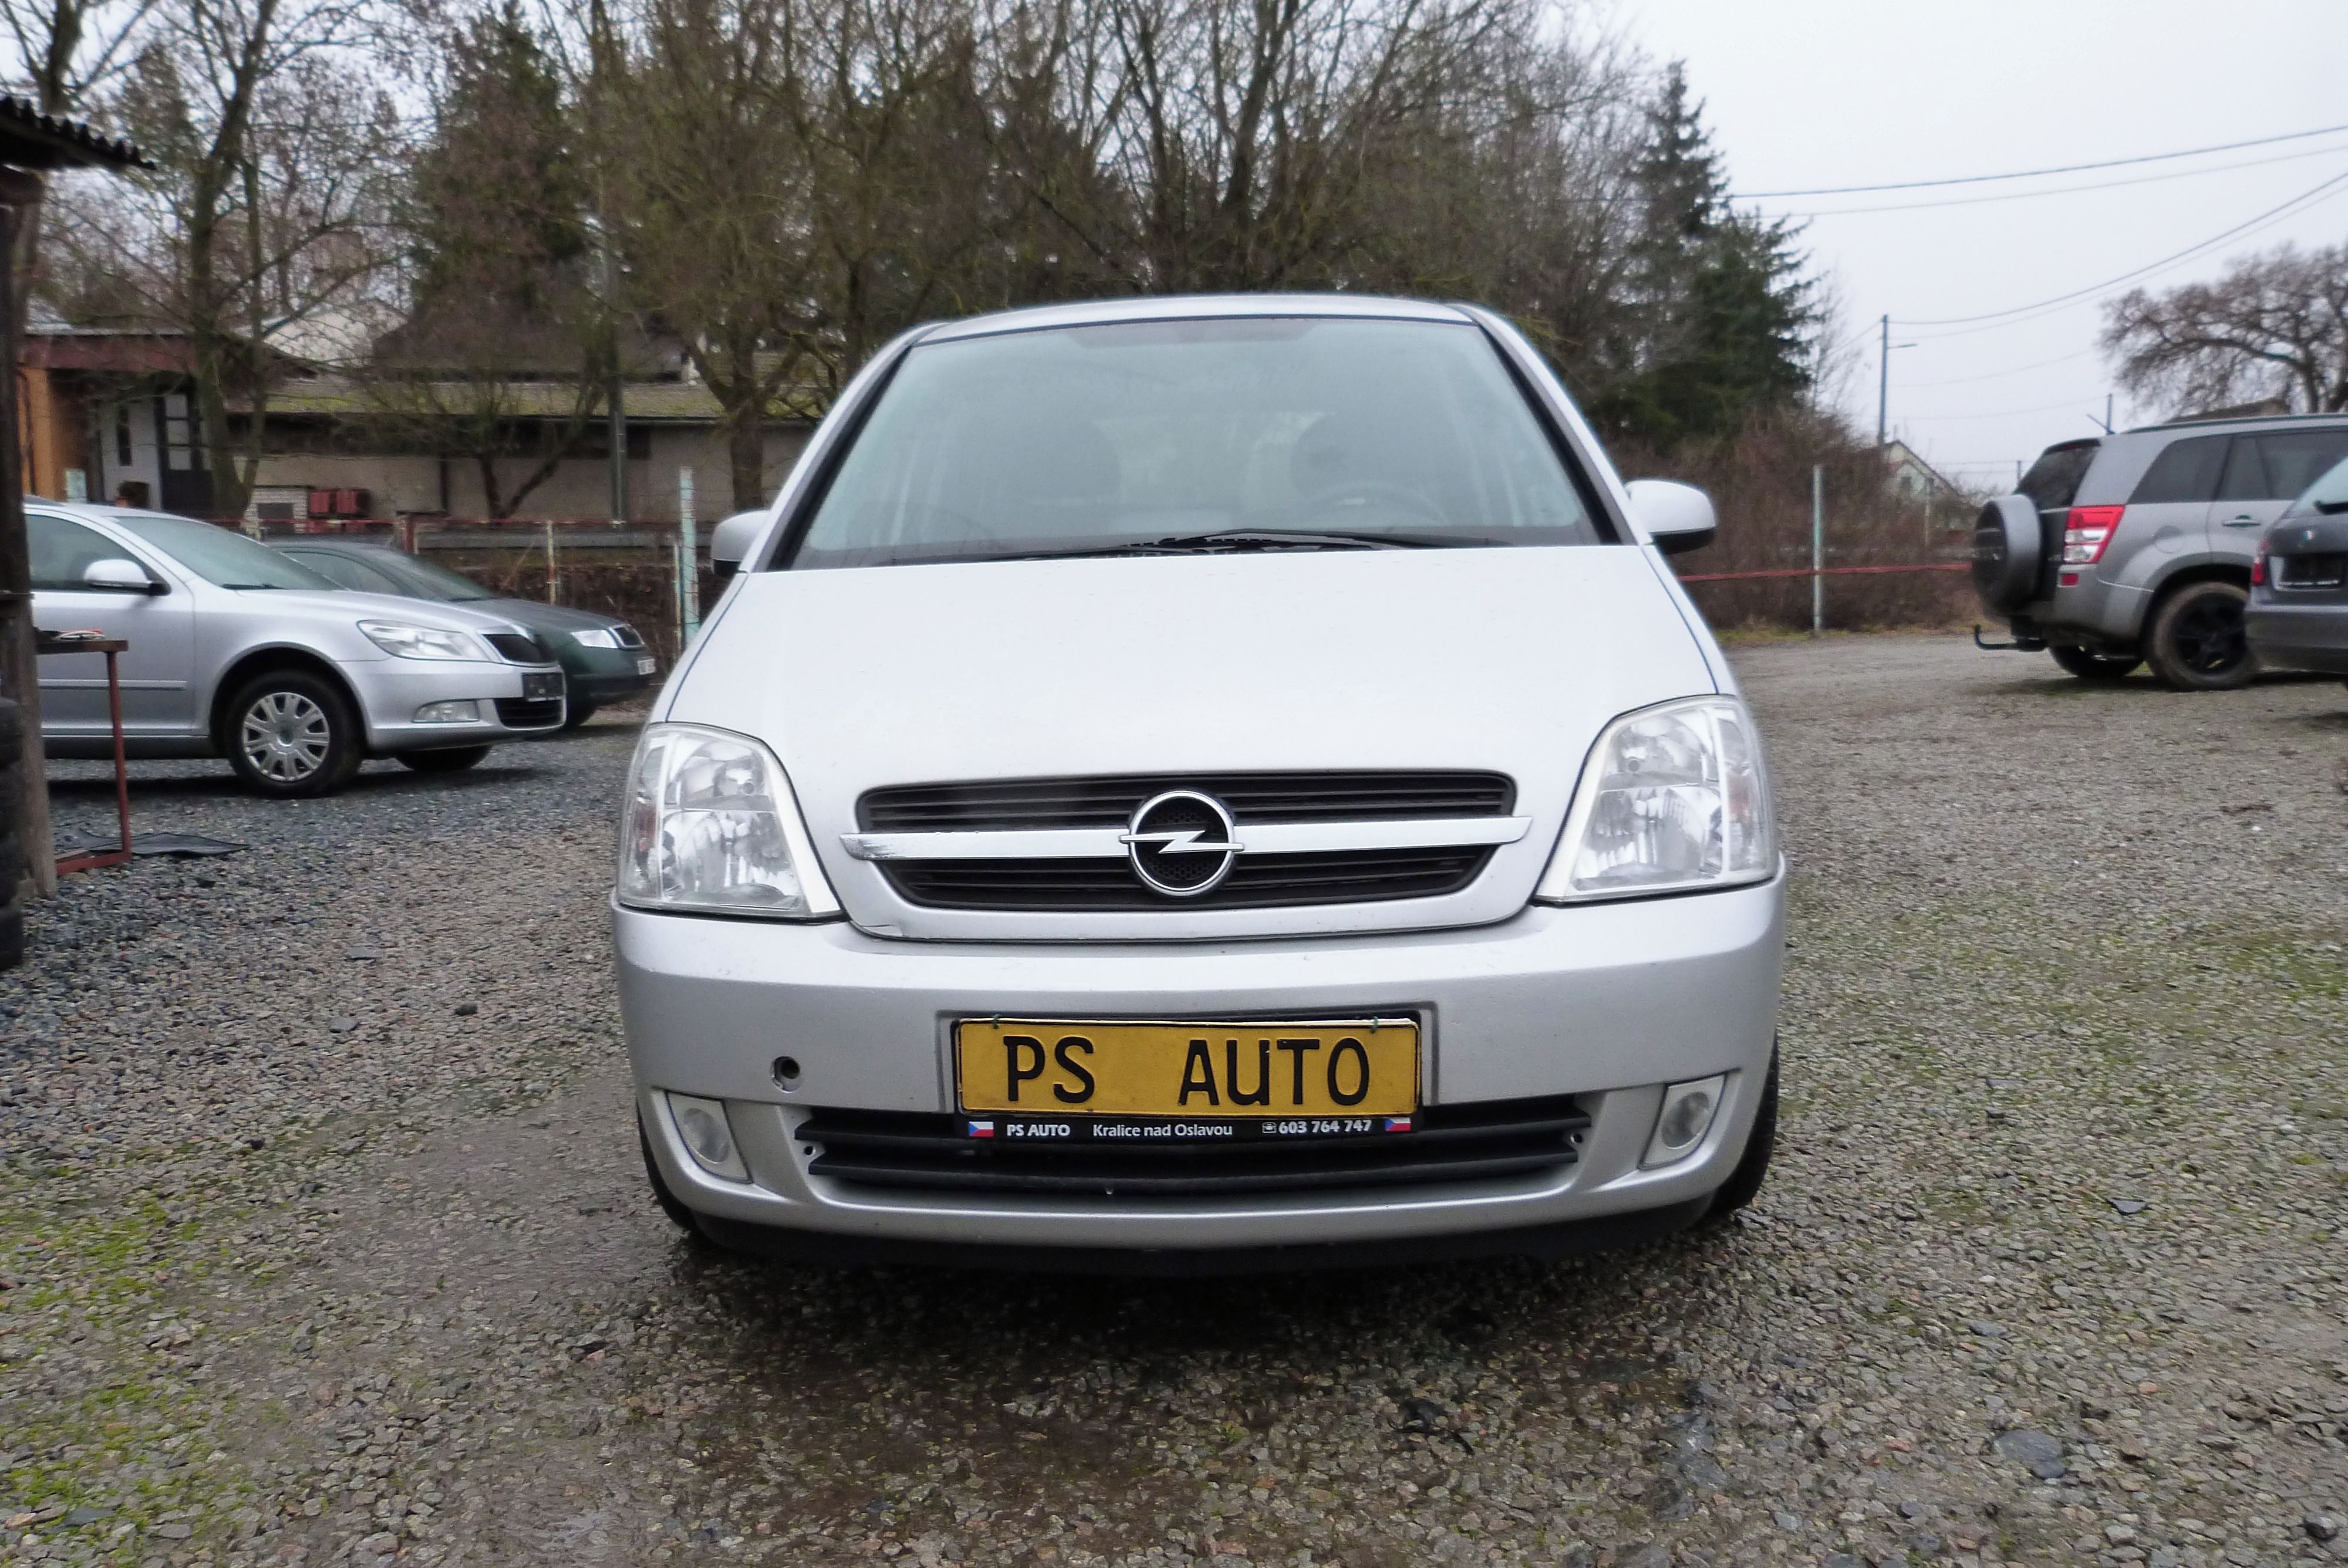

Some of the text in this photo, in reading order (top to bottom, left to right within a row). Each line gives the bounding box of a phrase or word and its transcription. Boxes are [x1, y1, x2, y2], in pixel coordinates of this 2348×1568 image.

[1003, 1036, 1370, 1106] PS AUTO
[1006, 1124, 1071, 1137] PS AUTO
[1092, 1123, 1232, 1137] Kralice nad Oslavou
[1278, 1119, 1372, 1134] 603 764 747
